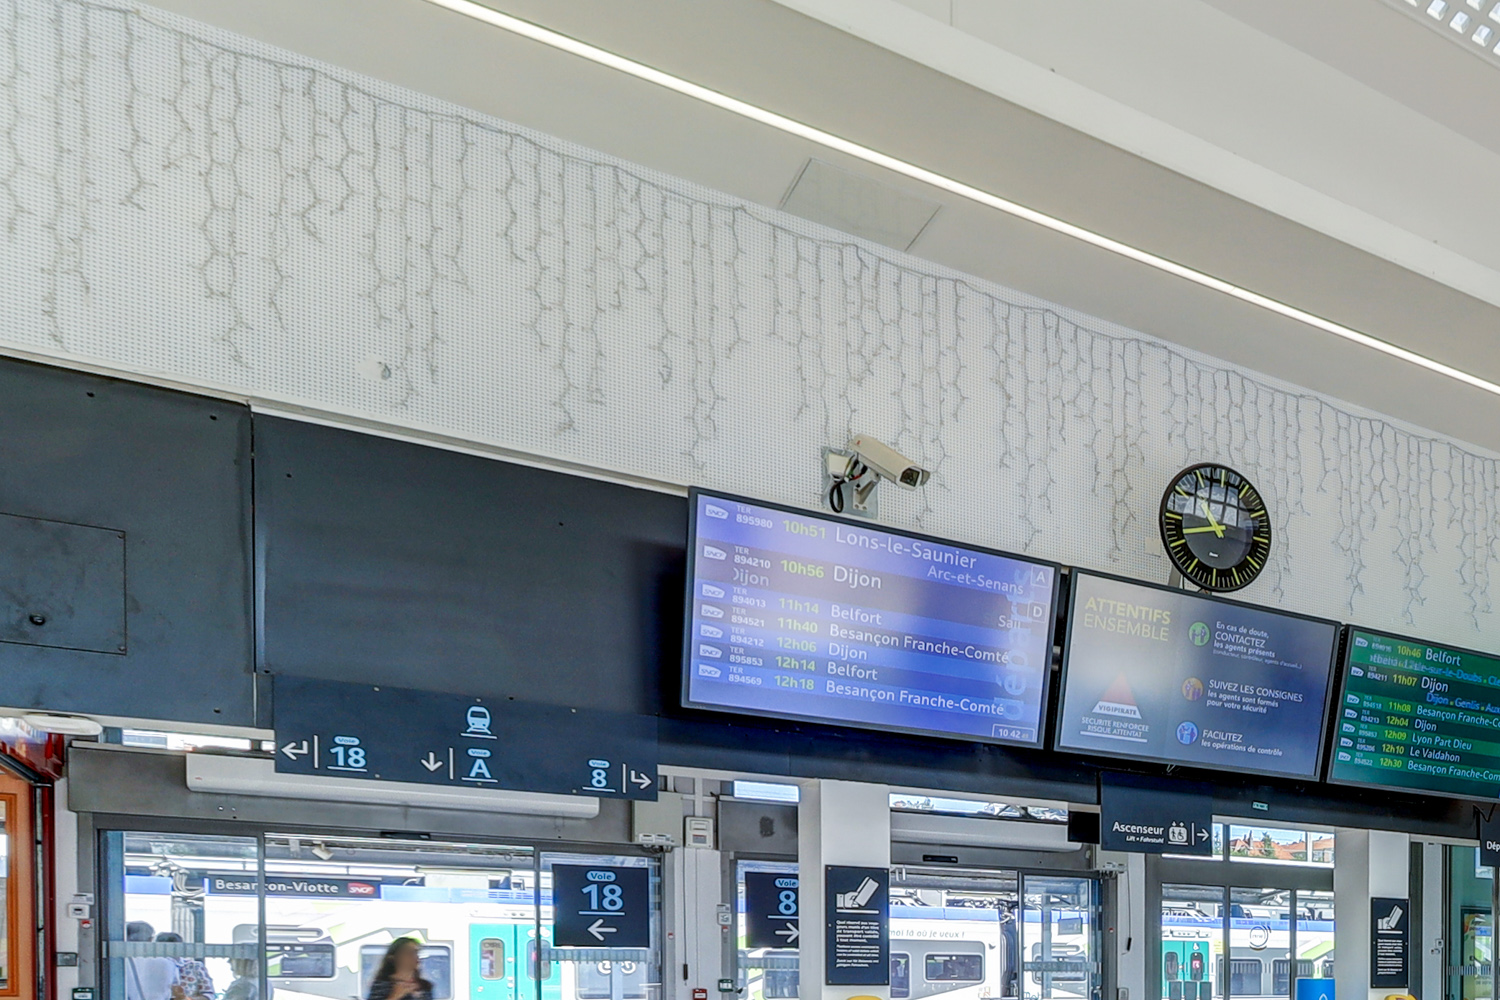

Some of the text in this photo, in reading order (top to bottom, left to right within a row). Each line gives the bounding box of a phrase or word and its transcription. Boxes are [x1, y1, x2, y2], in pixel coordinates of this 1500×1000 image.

[737, 505, 751, 514] TER
[735, 546, 750, 555] TER
[736, 514, 977, 569] 895980 10h51 Lons-le-Saunier
[734, 555, 882, 589] 894210 10h56 Dijon
[927, 565, 1024, 595] Arc-et-Senans
[1036, 572, 1046, 584] A
[733, 587, 747, 595] TER
[732, 607, 747, 615] TER
[779, 598, 820, 614] 11h14
[831, 605, 882, 626] Belfort
[1033, 607, 1043, 618] D
[1085, 596, 1171, 625] ATTENTIFS
[731, 627, 746, 635] TER
[1084, 613, 1170, 642] ENSEMBLE
[730, 635, 868, 661] 894212 12h06 Dijon
[731, 615, 1009, 664] 894521 11h40 Besançon Franche-Comté
[1215, 631, 1266, 649] CONTACTEZ
[730, 646, 745, 654] TER
[1214, 641, 1276, 659] les agents présents
[1397, 645, 1422, 659] 10h46
[1426, 648, 1461, 667] Belfort
[729, 666, 744, 674] TER
[730, 654, 878, 681] 895853 12h14 Belfort
[1209, 679, 1304, 703] SUIVEZ LES CONSIGNES
[1393, 674, 1418, 687] 11h07
[1421, 677, 1449, 693] Dijon
[728, 674, 1004, 716] 894569 12h18 Besançon Franche-Comté
[1208, 690, 1218, 698] les
[1219, 692, 1241, 703] agents
[1098, 705, 1137, 716] VIGIPIRATE
[1224, 701, 1241, 711] votre
[1242, 704, 1267, 714] sécurité
[1389, 702, 1412, 713] 11h08
[1417, 705, 1456, 721] Besançon
[1386, 716, 1409, 727] 12h04
[1415, 719, 1437, 732] Dijon
[1203, 729, 1243, 743] FACILITEZ
[1384, 730, 1472, 751] 12h09 Lyon Part Dieu
[1201, 739, 1211, 748] les
[1212, 742, 1246, 753] opérations
[1382, 744, 1461, 763] 12h10 Le Valdahon
[330, 746, 367, 768] 18
[469, 759, 492, 779] A
[1380, 758, 1402, 768] 12h30
[1408, 760, 1447, 775] Besançon
[590, 769, 607, 788] 8
[1113, 821, 1165, 835] Ascenseur
[591, 871, 613, 881] Voie
[778, 879, 798, 888] Voie
[215, 879, 374, 894] Besaon-Viotte SNCF
[581, 884, 624, 911] 18
[778, 890, 797, 915] 8
